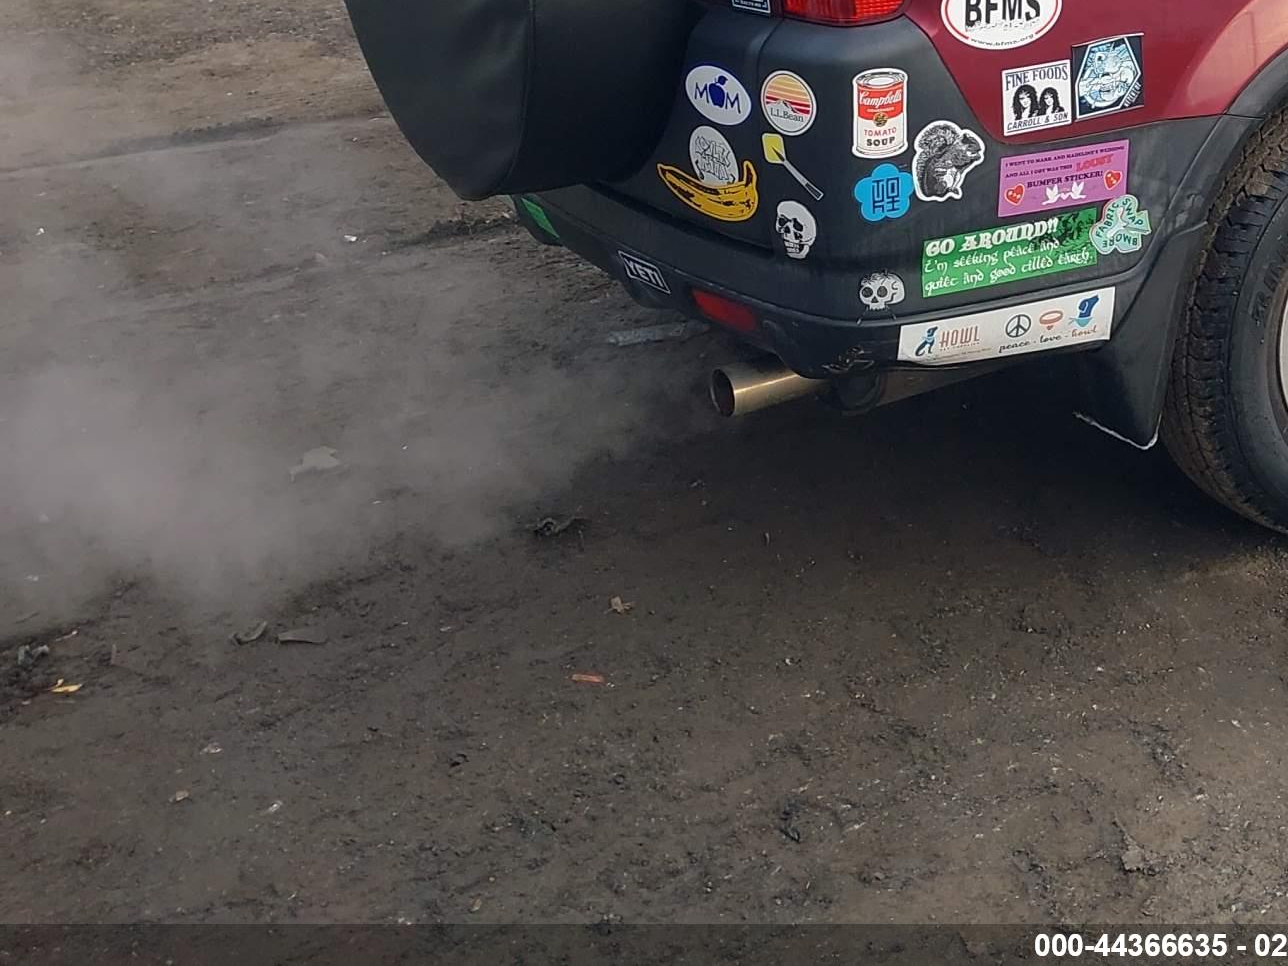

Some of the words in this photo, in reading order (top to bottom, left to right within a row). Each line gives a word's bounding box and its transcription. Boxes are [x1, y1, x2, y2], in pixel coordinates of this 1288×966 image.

[1005, 71, 1030, 91] FINE
[1032, 65, 1069, 81] FOODS
[1007, 117, 1042, 130] CARROLL
[1044, 115, 1050, 123] &
[1053, 112, 1069, 122] SON
[864, 126, 897, 137] TOMATO
[866, 136, 896, 147] SOUP
[1075, 154, 1114, 172] LOUSY
[1026, 175, 1063, 188] BUMPER
[1063, 170, 1103, 183] STICKER!
[1096, 202, 1119, 238] FABRIC
[1122, 198, 1144, 225] SWAP
[925, 240, 956, 257] GO
[1102, 234, 1138, 248] BMORE
[624, 257, 664, 287] YETI
[989, 264, 1016, 284] good
[939, 325, 980, 347] HOWL
[998, 340, 1031, 354] peace
[1039, 334, 1063, 345] love
